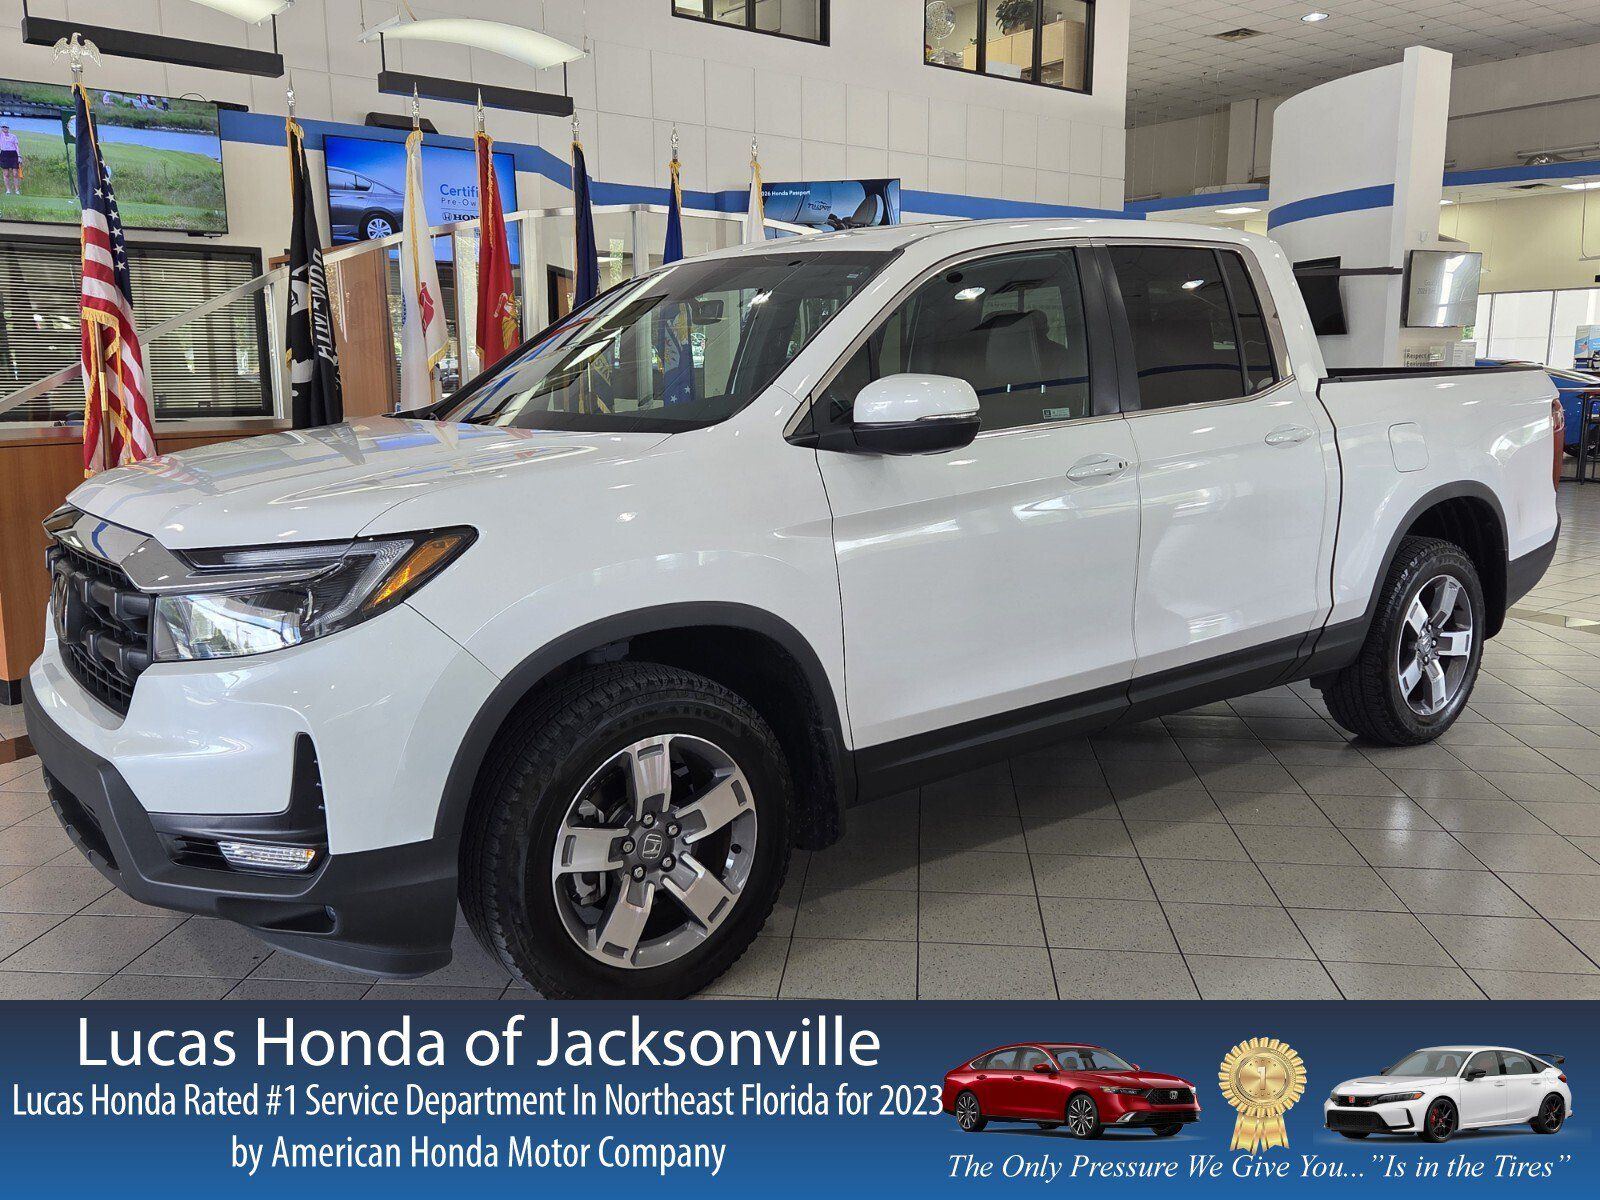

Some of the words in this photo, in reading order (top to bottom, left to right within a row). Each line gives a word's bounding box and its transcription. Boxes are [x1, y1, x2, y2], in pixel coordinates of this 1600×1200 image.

[440, 184, 479, 198] Certifi
[441, 197, 476, 207] Pre-Ow
[453, 212, 479, 221] HON
